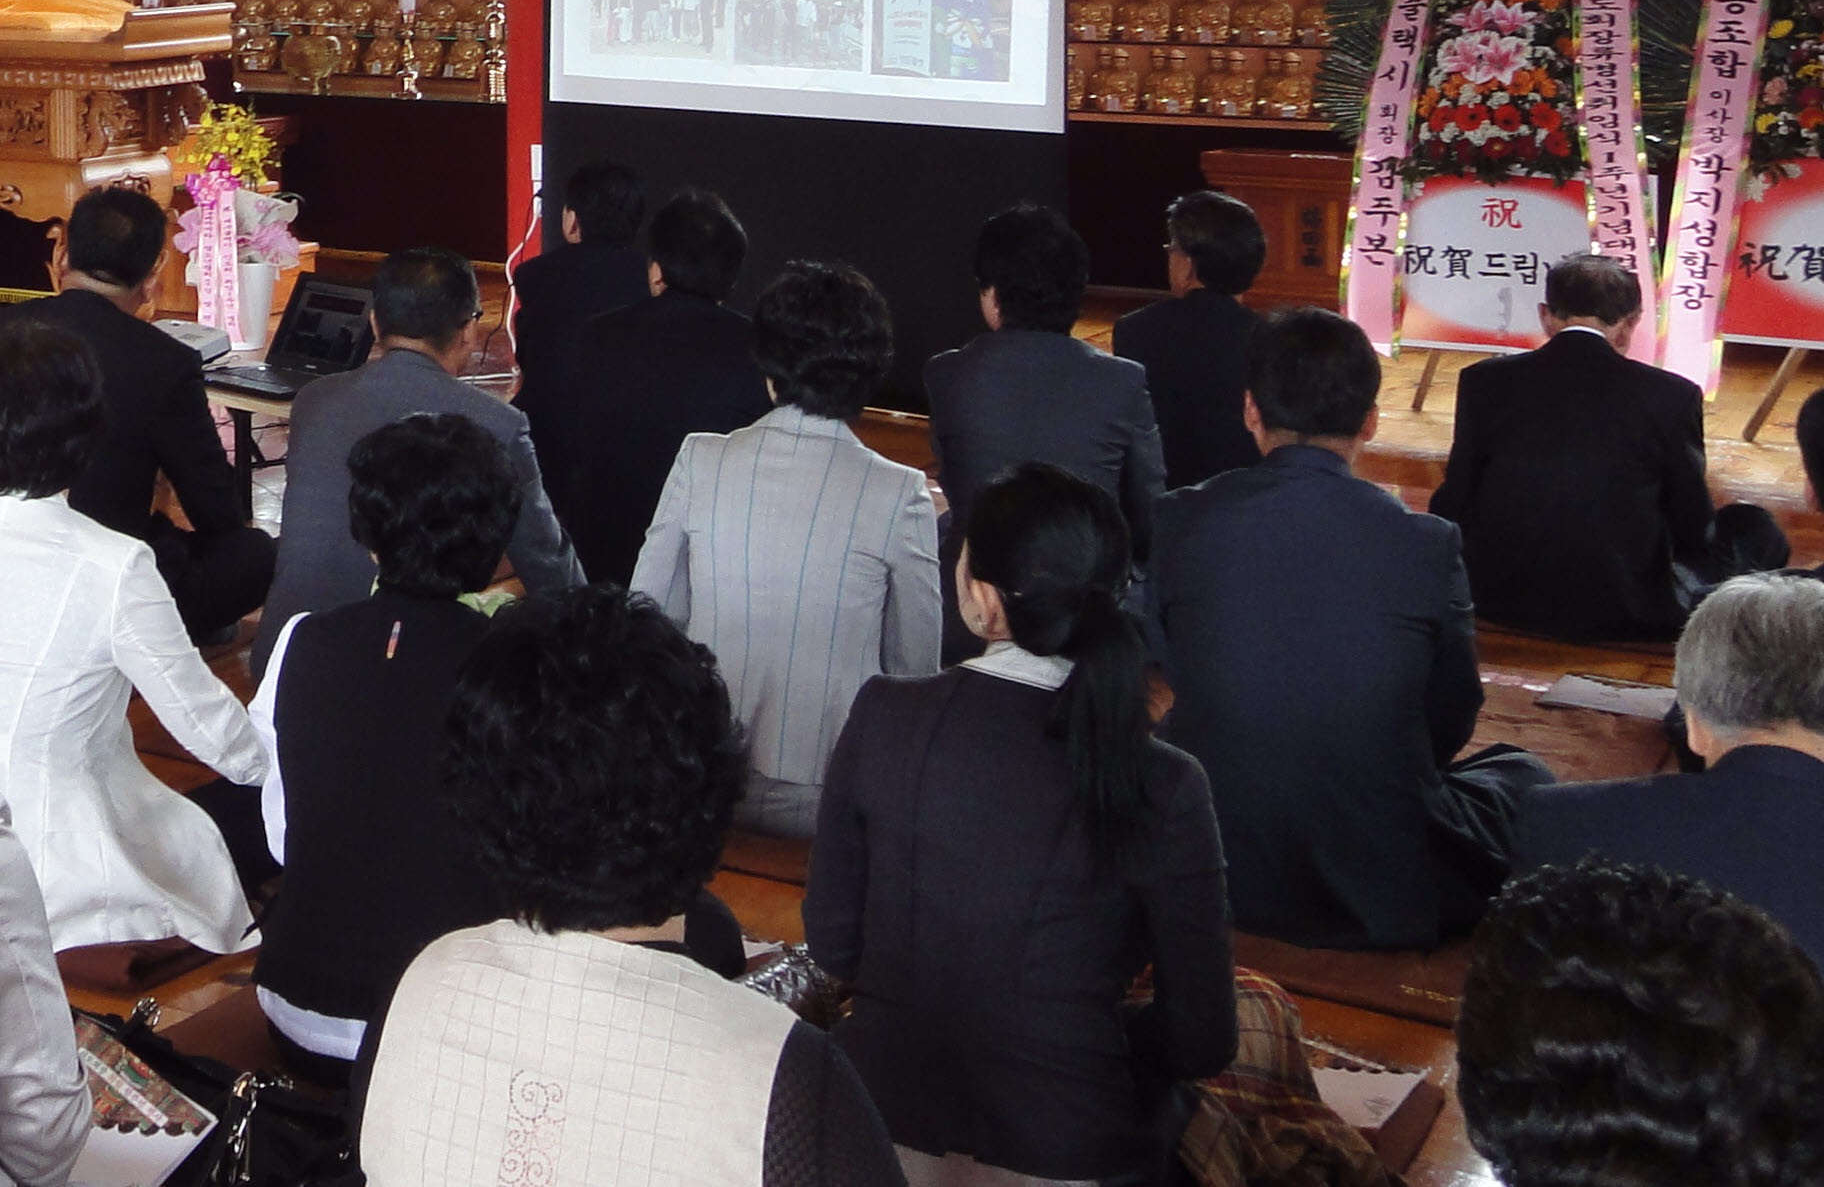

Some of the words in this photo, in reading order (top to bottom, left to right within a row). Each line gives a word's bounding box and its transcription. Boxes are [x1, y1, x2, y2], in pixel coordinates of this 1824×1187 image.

[1377, 103, 1399, 145] 회장
[1704, 88, 1732, 144] 이사장
[1480, 198, 1523, 229] 祝
[1404, 243, 1474, 280] 祝賀
[1478, 251, 1553, 286] 드립
